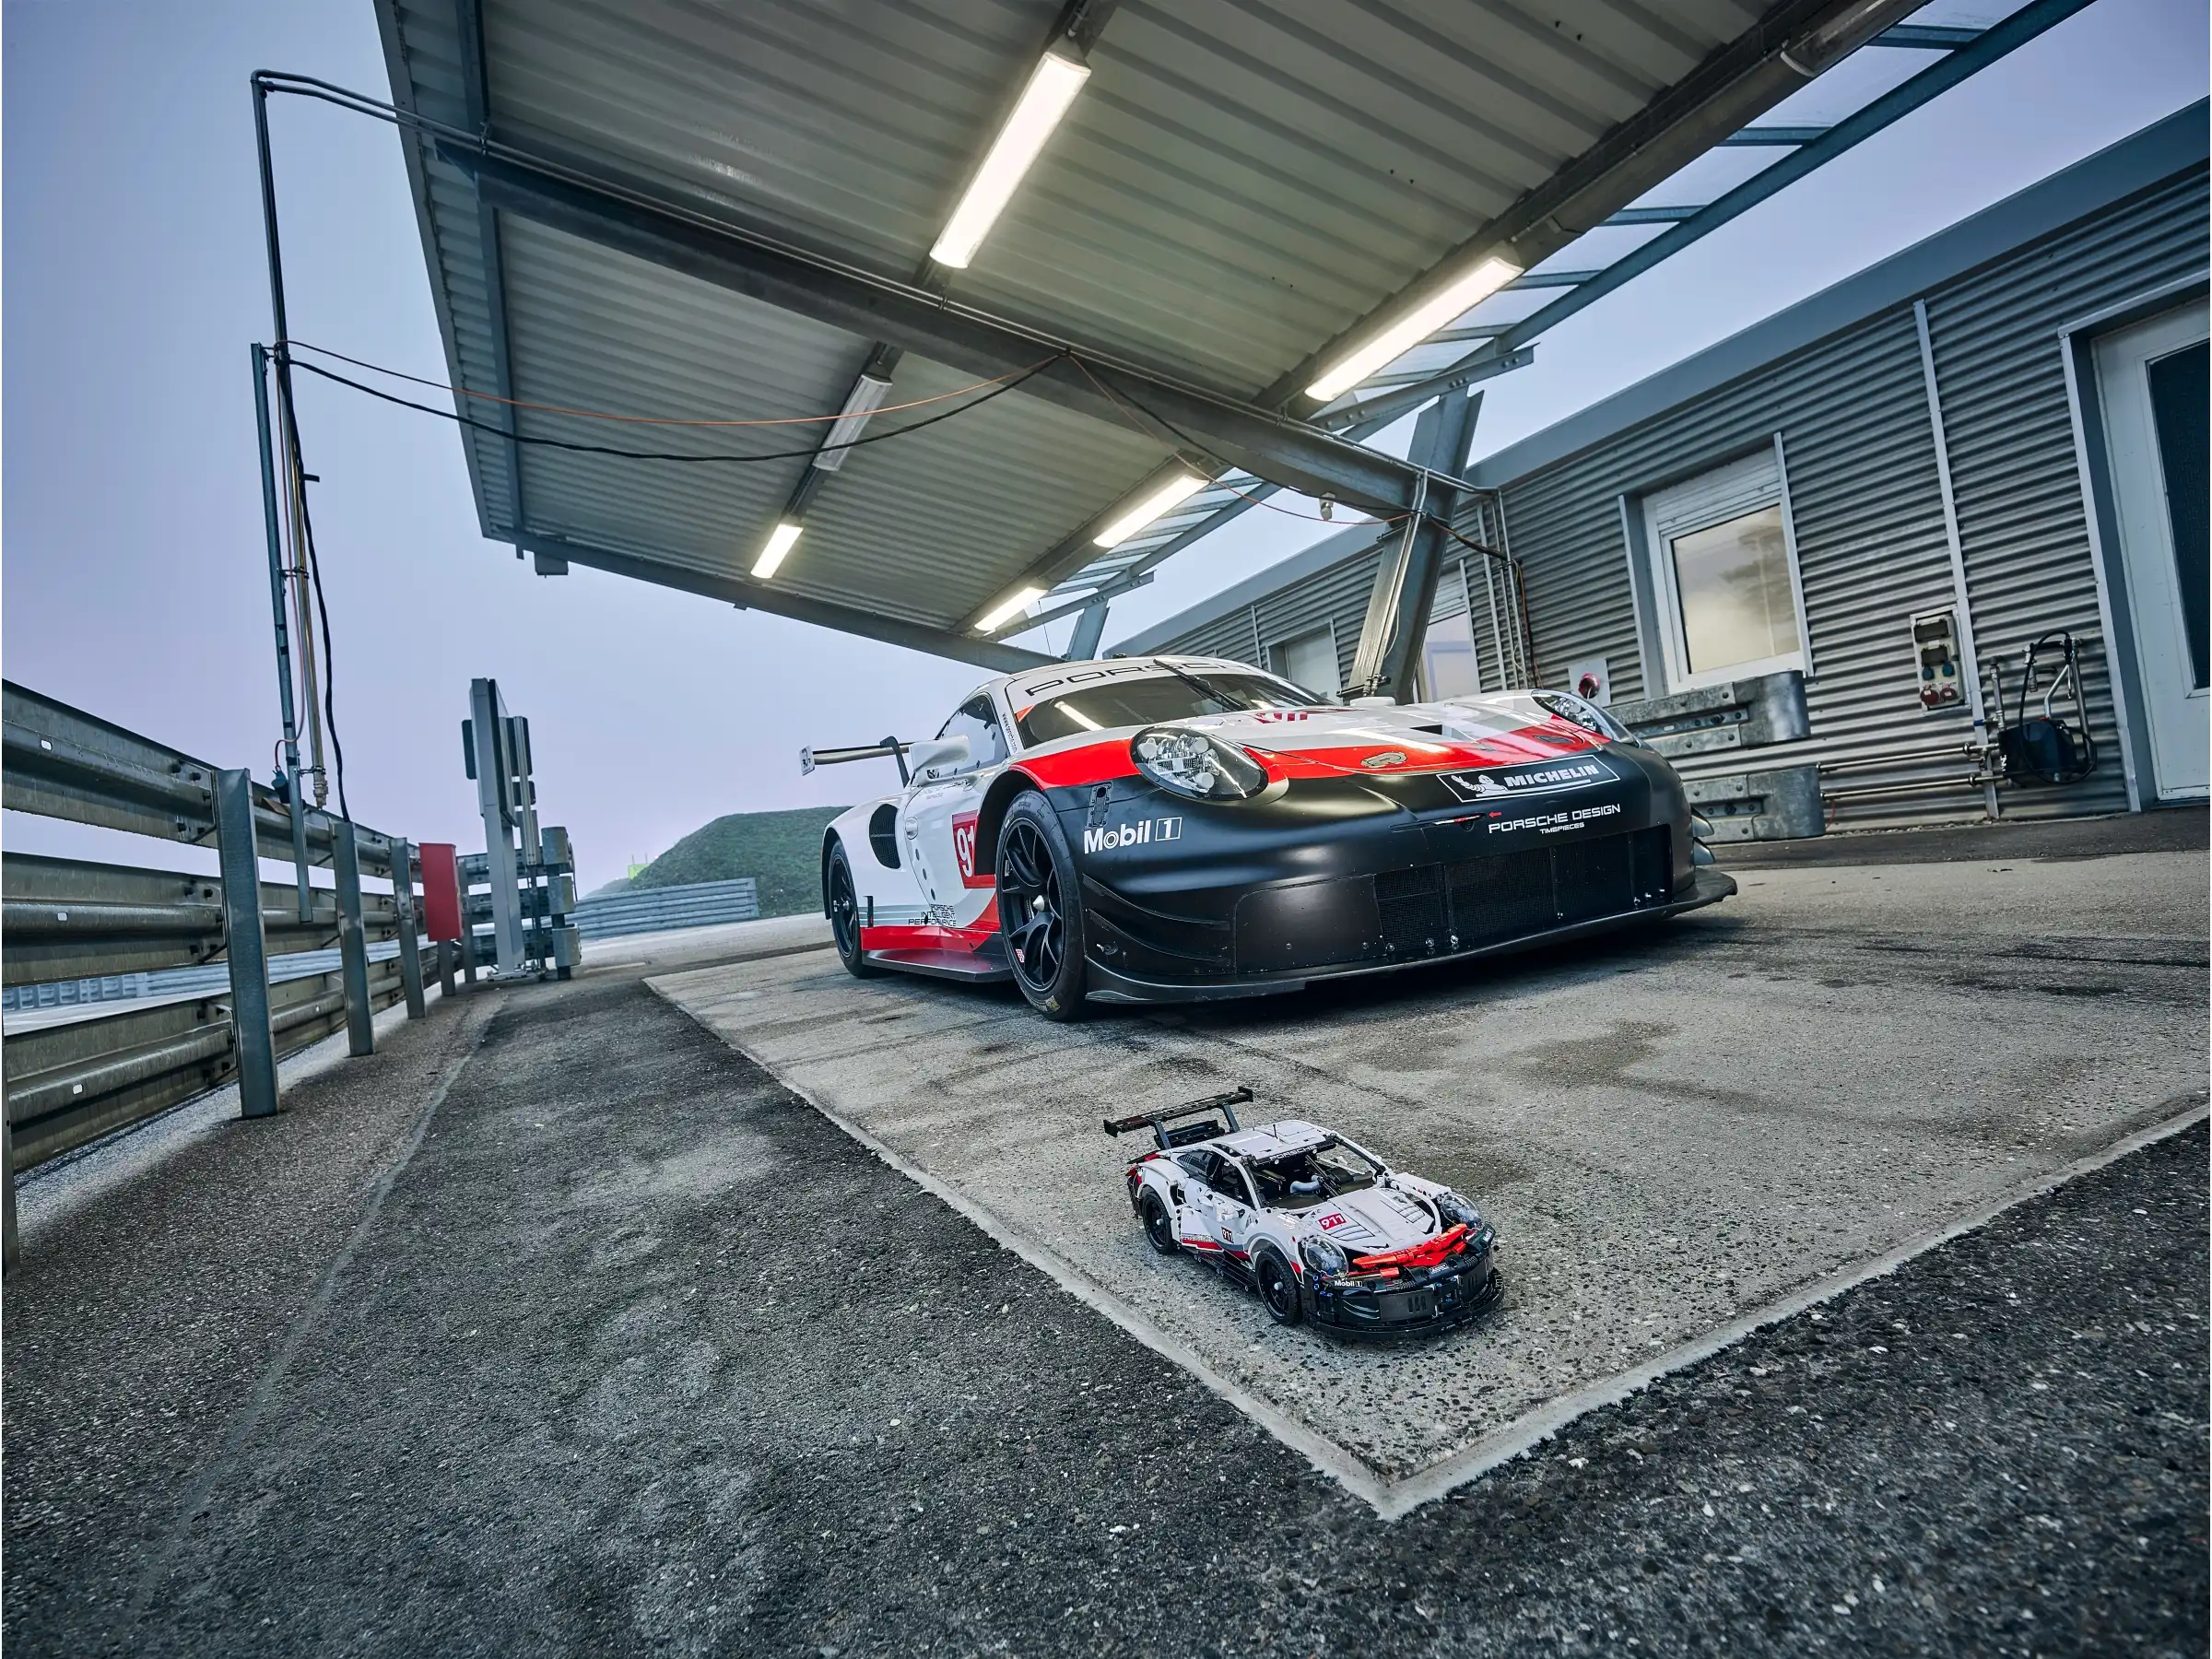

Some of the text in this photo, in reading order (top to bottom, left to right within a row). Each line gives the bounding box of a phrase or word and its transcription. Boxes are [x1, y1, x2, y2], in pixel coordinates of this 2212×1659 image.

[1024, 663, 1251, 697] PORSCH
[1503, 764, 1600, 787] MICHELIN
[1488, 804, 1621, 834] PORSCHE DESIGN
[1539, 821, 1585, 835] TIMEPIECES
[1084, 819, 1151, 854] Mobil
[1269, 1144, 1318, 1160] PORSCHE
[1321, 1214, 1345, 1229] 911
[1222, 1228, 1233, 1242] 911
